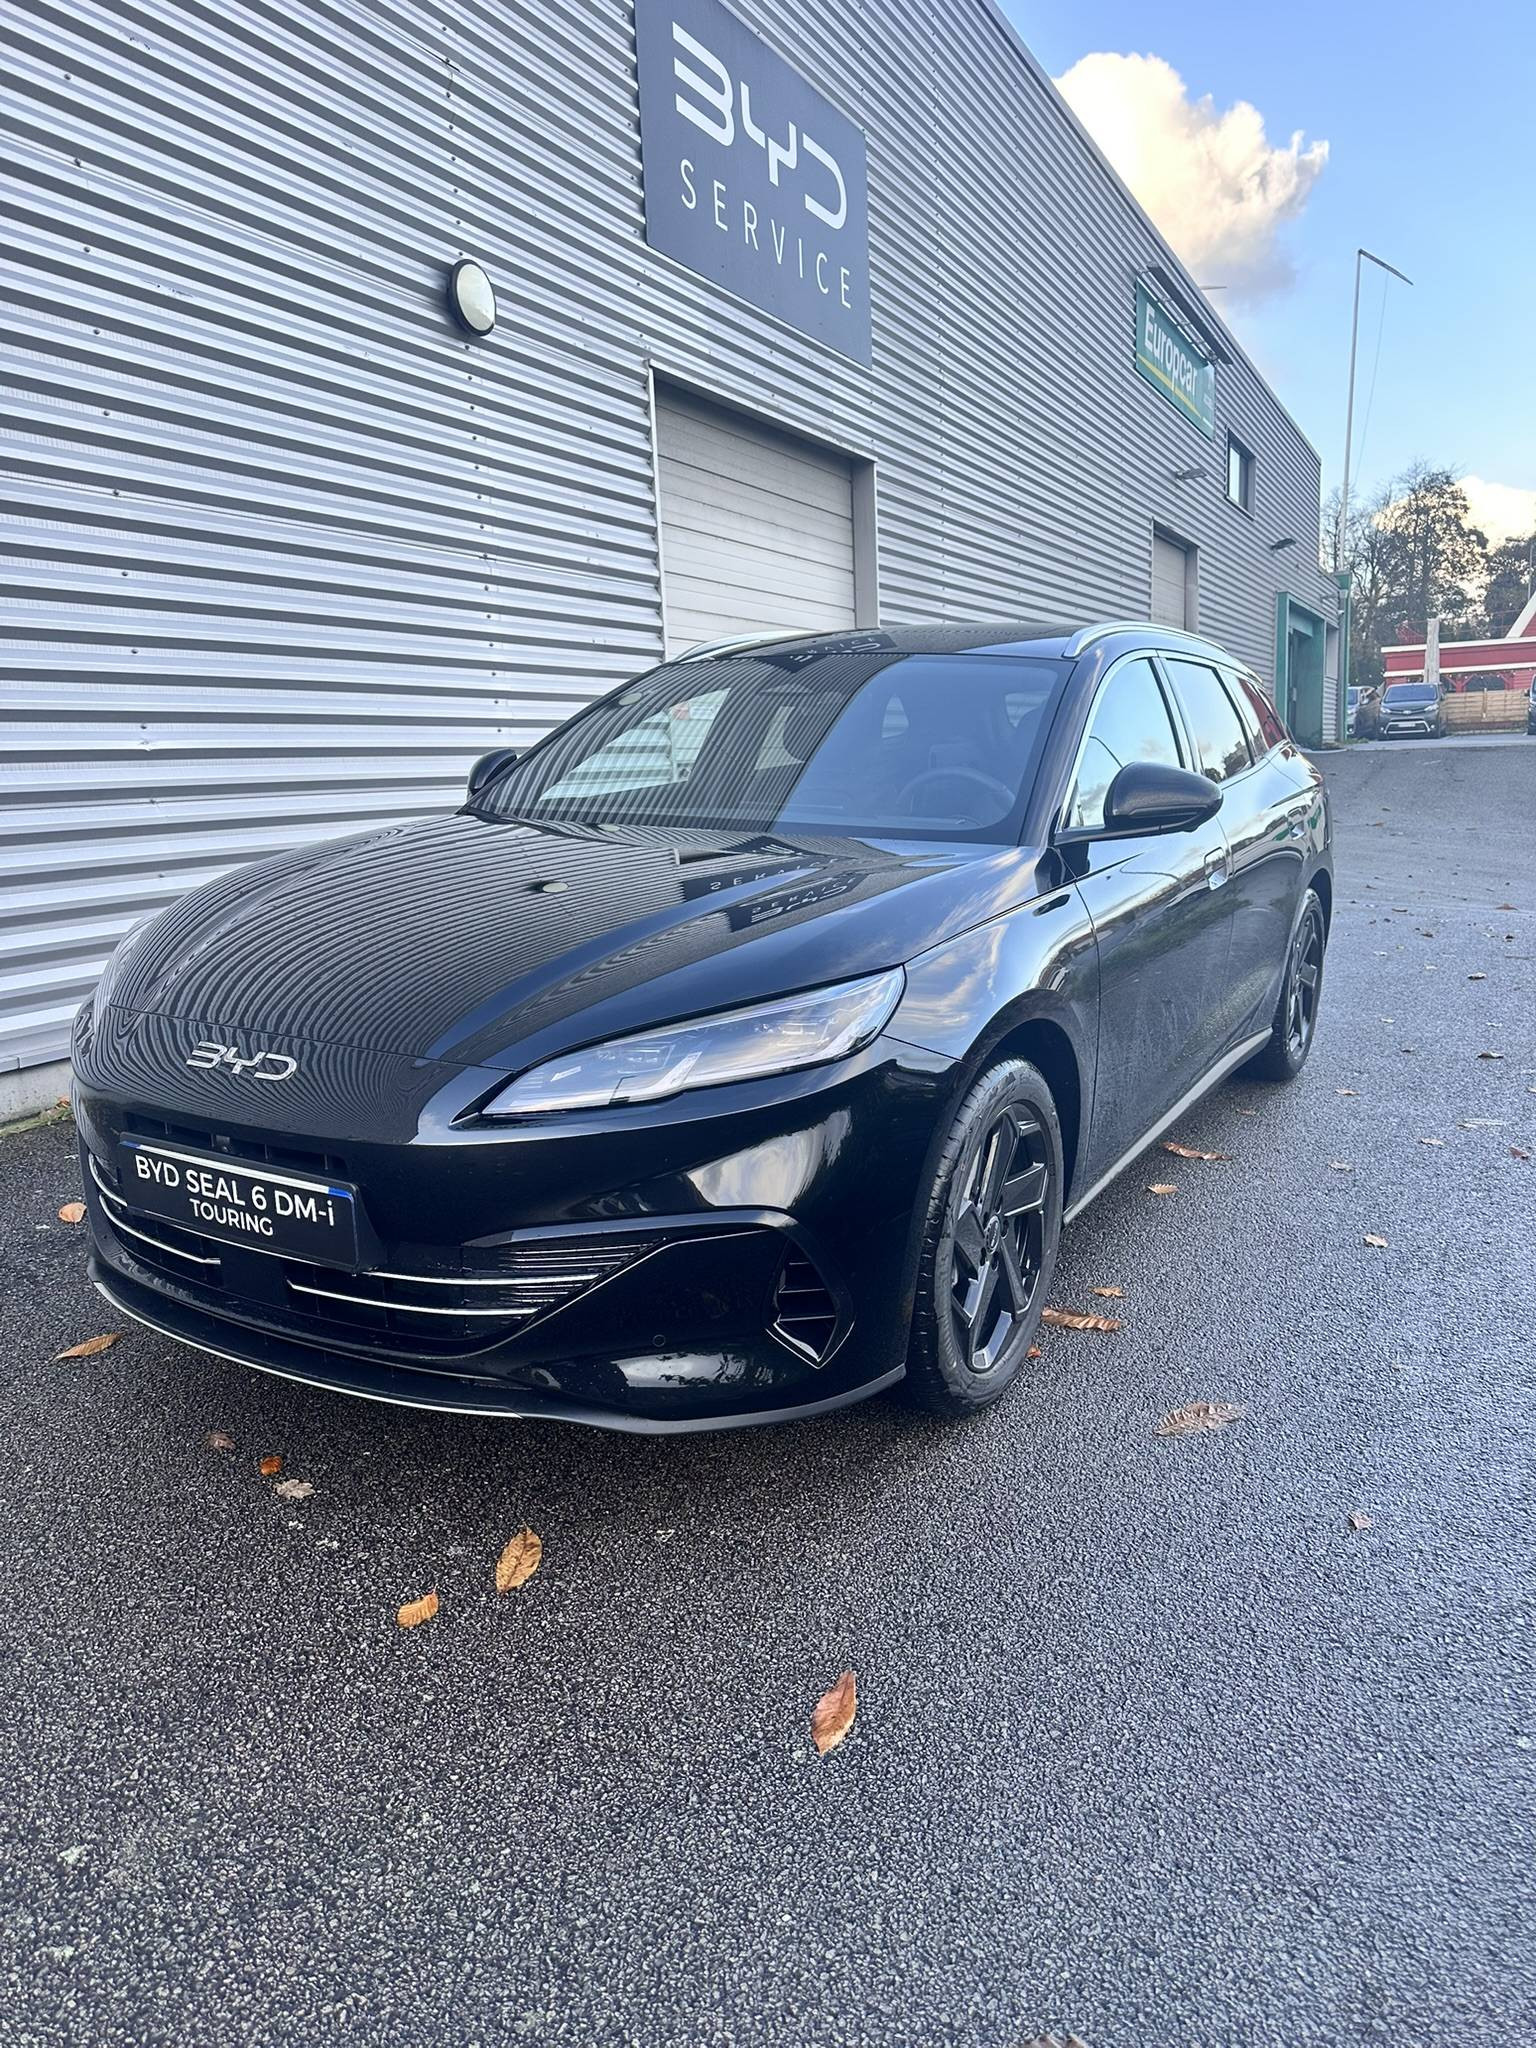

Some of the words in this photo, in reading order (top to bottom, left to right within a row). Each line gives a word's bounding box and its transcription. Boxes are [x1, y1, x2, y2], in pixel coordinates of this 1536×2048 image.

[672, 21, 847, 230] BYD
[680, 159, 851, 309] SERVICE
[1144, 302, 1198, 396] Europcar
[186, 1040, 297, 1081] BYD
[135, 1154, 180, 1187] BYD
[186, 1169, 246, 1207] SEAL
[251, 1185, 267, 1210] 6
[274, 1190, 335, 1226] DM-i
[189, 1198, 274, 1236] TOURING
